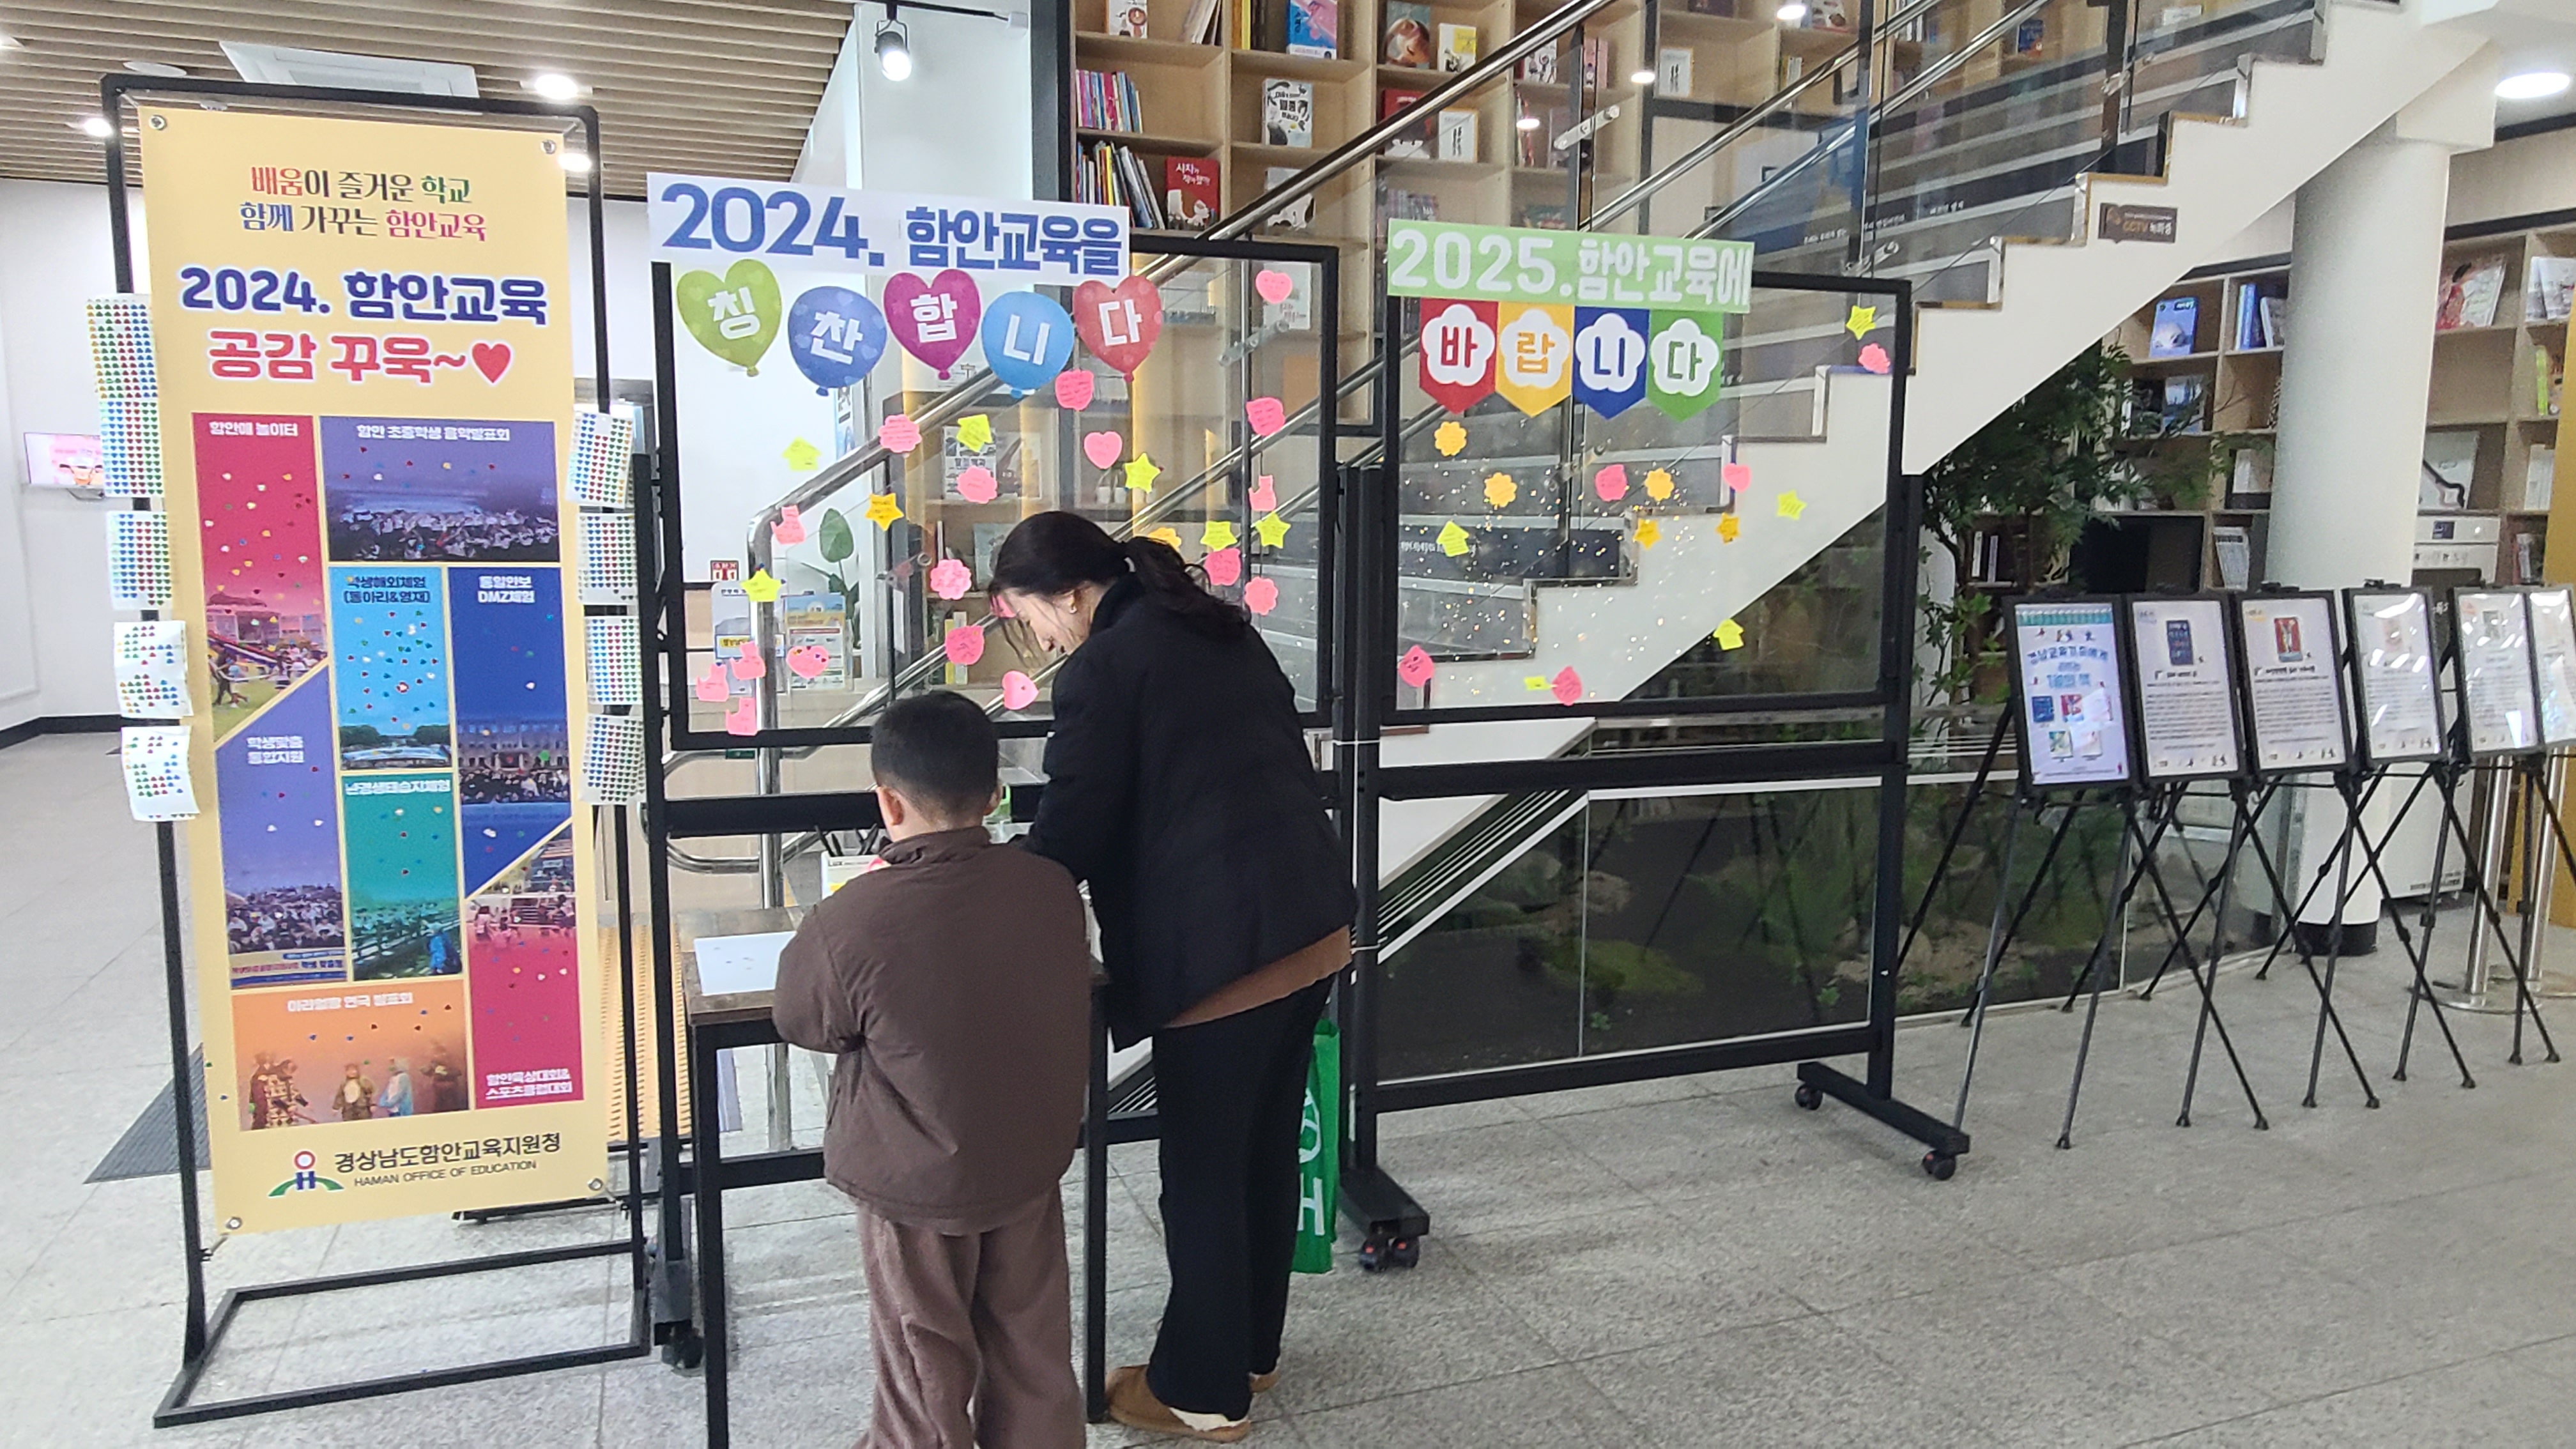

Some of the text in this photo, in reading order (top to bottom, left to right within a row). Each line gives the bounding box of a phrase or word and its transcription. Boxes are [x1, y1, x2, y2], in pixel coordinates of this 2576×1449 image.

[250, 166, 471, 204] 배움이 즐거운 학교
[240, 202, 487, 241] 함께 가꾸는 함안교육
[662, 183, 1120, 277] 2024. 함안교육을
[180, 266, 548, 326] 2024. 함안교육
[208, 330, 316, 379] 공감
[1441, 325, 1702, 381] 바랍니다
[256, 423, 298, 436] 놀이터
[357, 425, 385, 438] 함안
[478, 591, 535, 603] DMZ체험
[335, 1133, 561, 1173] 경상남도함안교육지원청
[354, 1160, 537, 1187] HAMAN OFFICE OF EDUCATION
